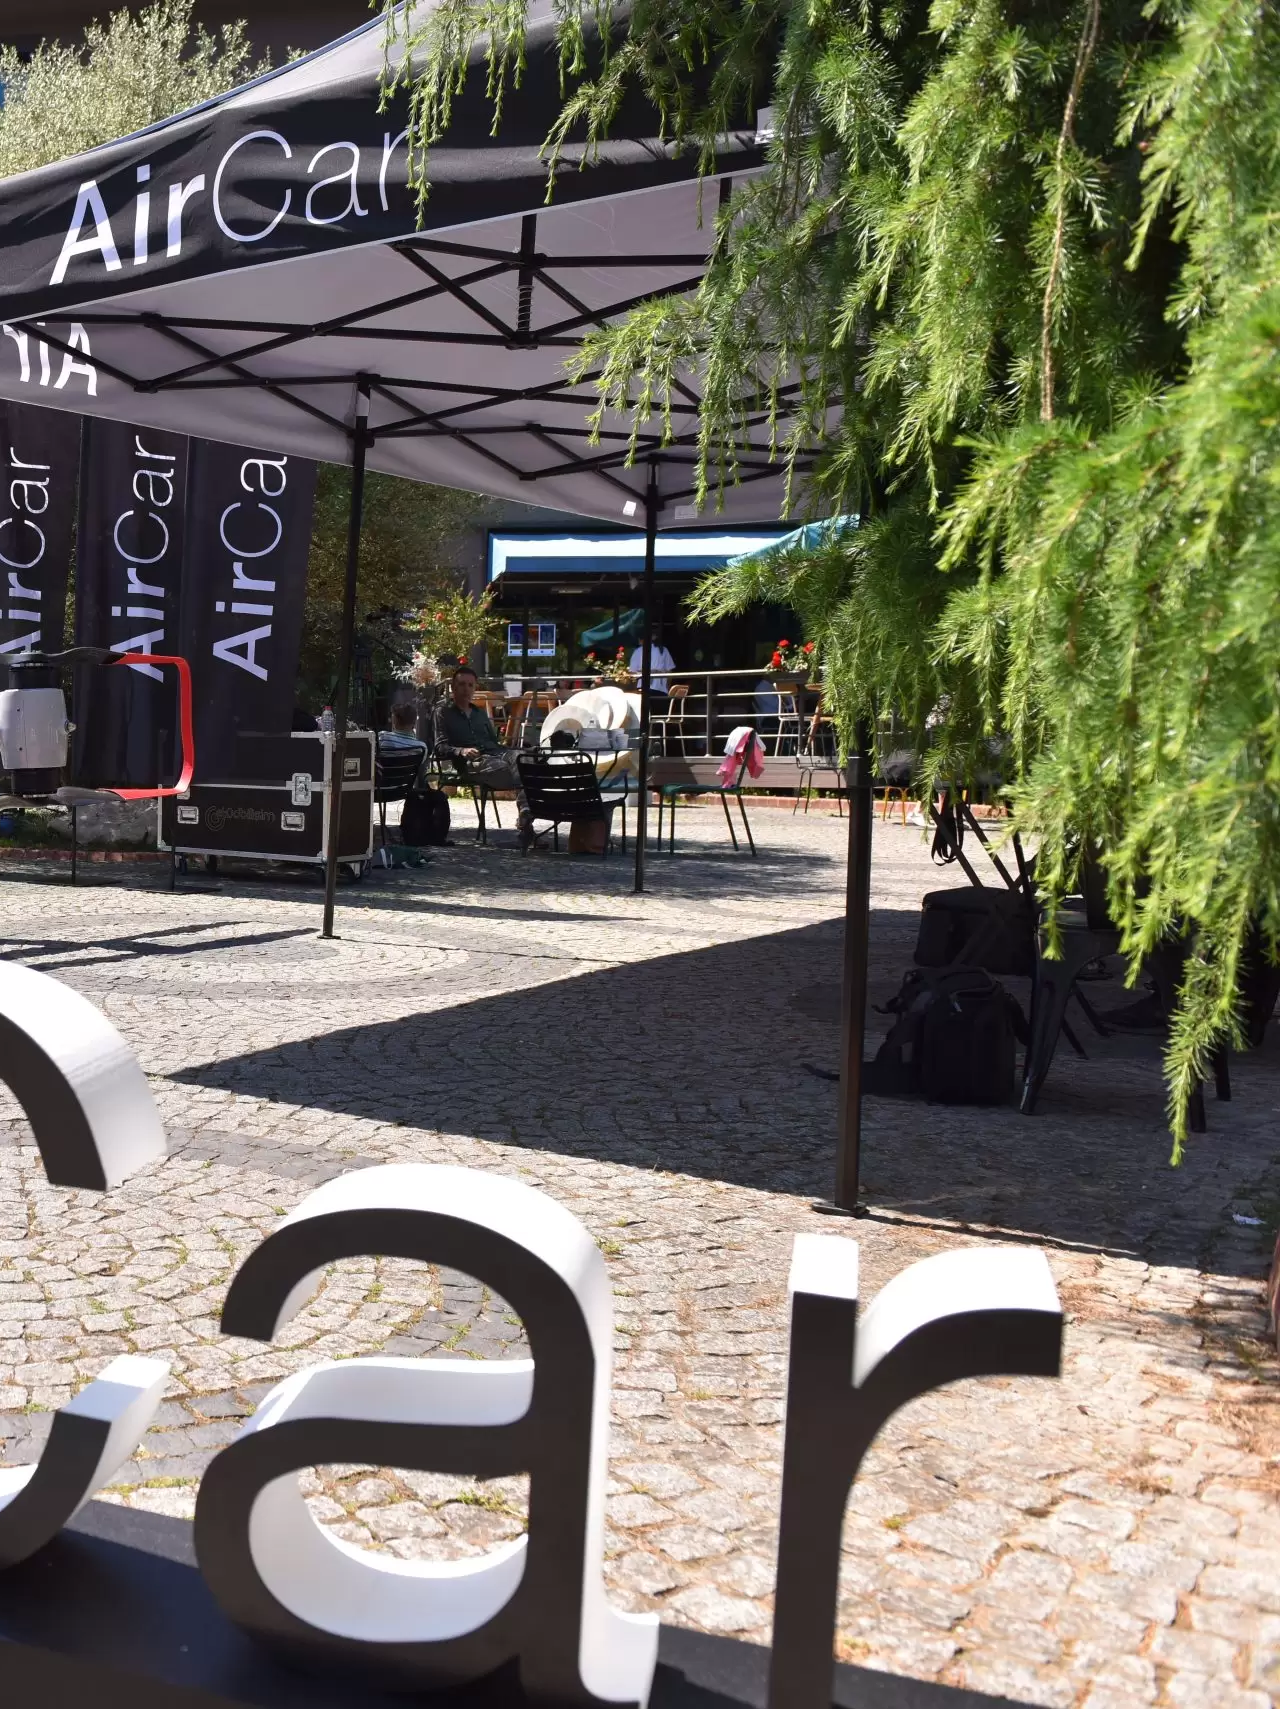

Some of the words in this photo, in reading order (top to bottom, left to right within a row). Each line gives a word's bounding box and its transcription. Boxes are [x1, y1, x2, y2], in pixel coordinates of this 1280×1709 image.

[49, 125, 420, 286] AirCar
[110, 434, 176, 683] AirCar
[212, 456, 288, 682] AirCa
